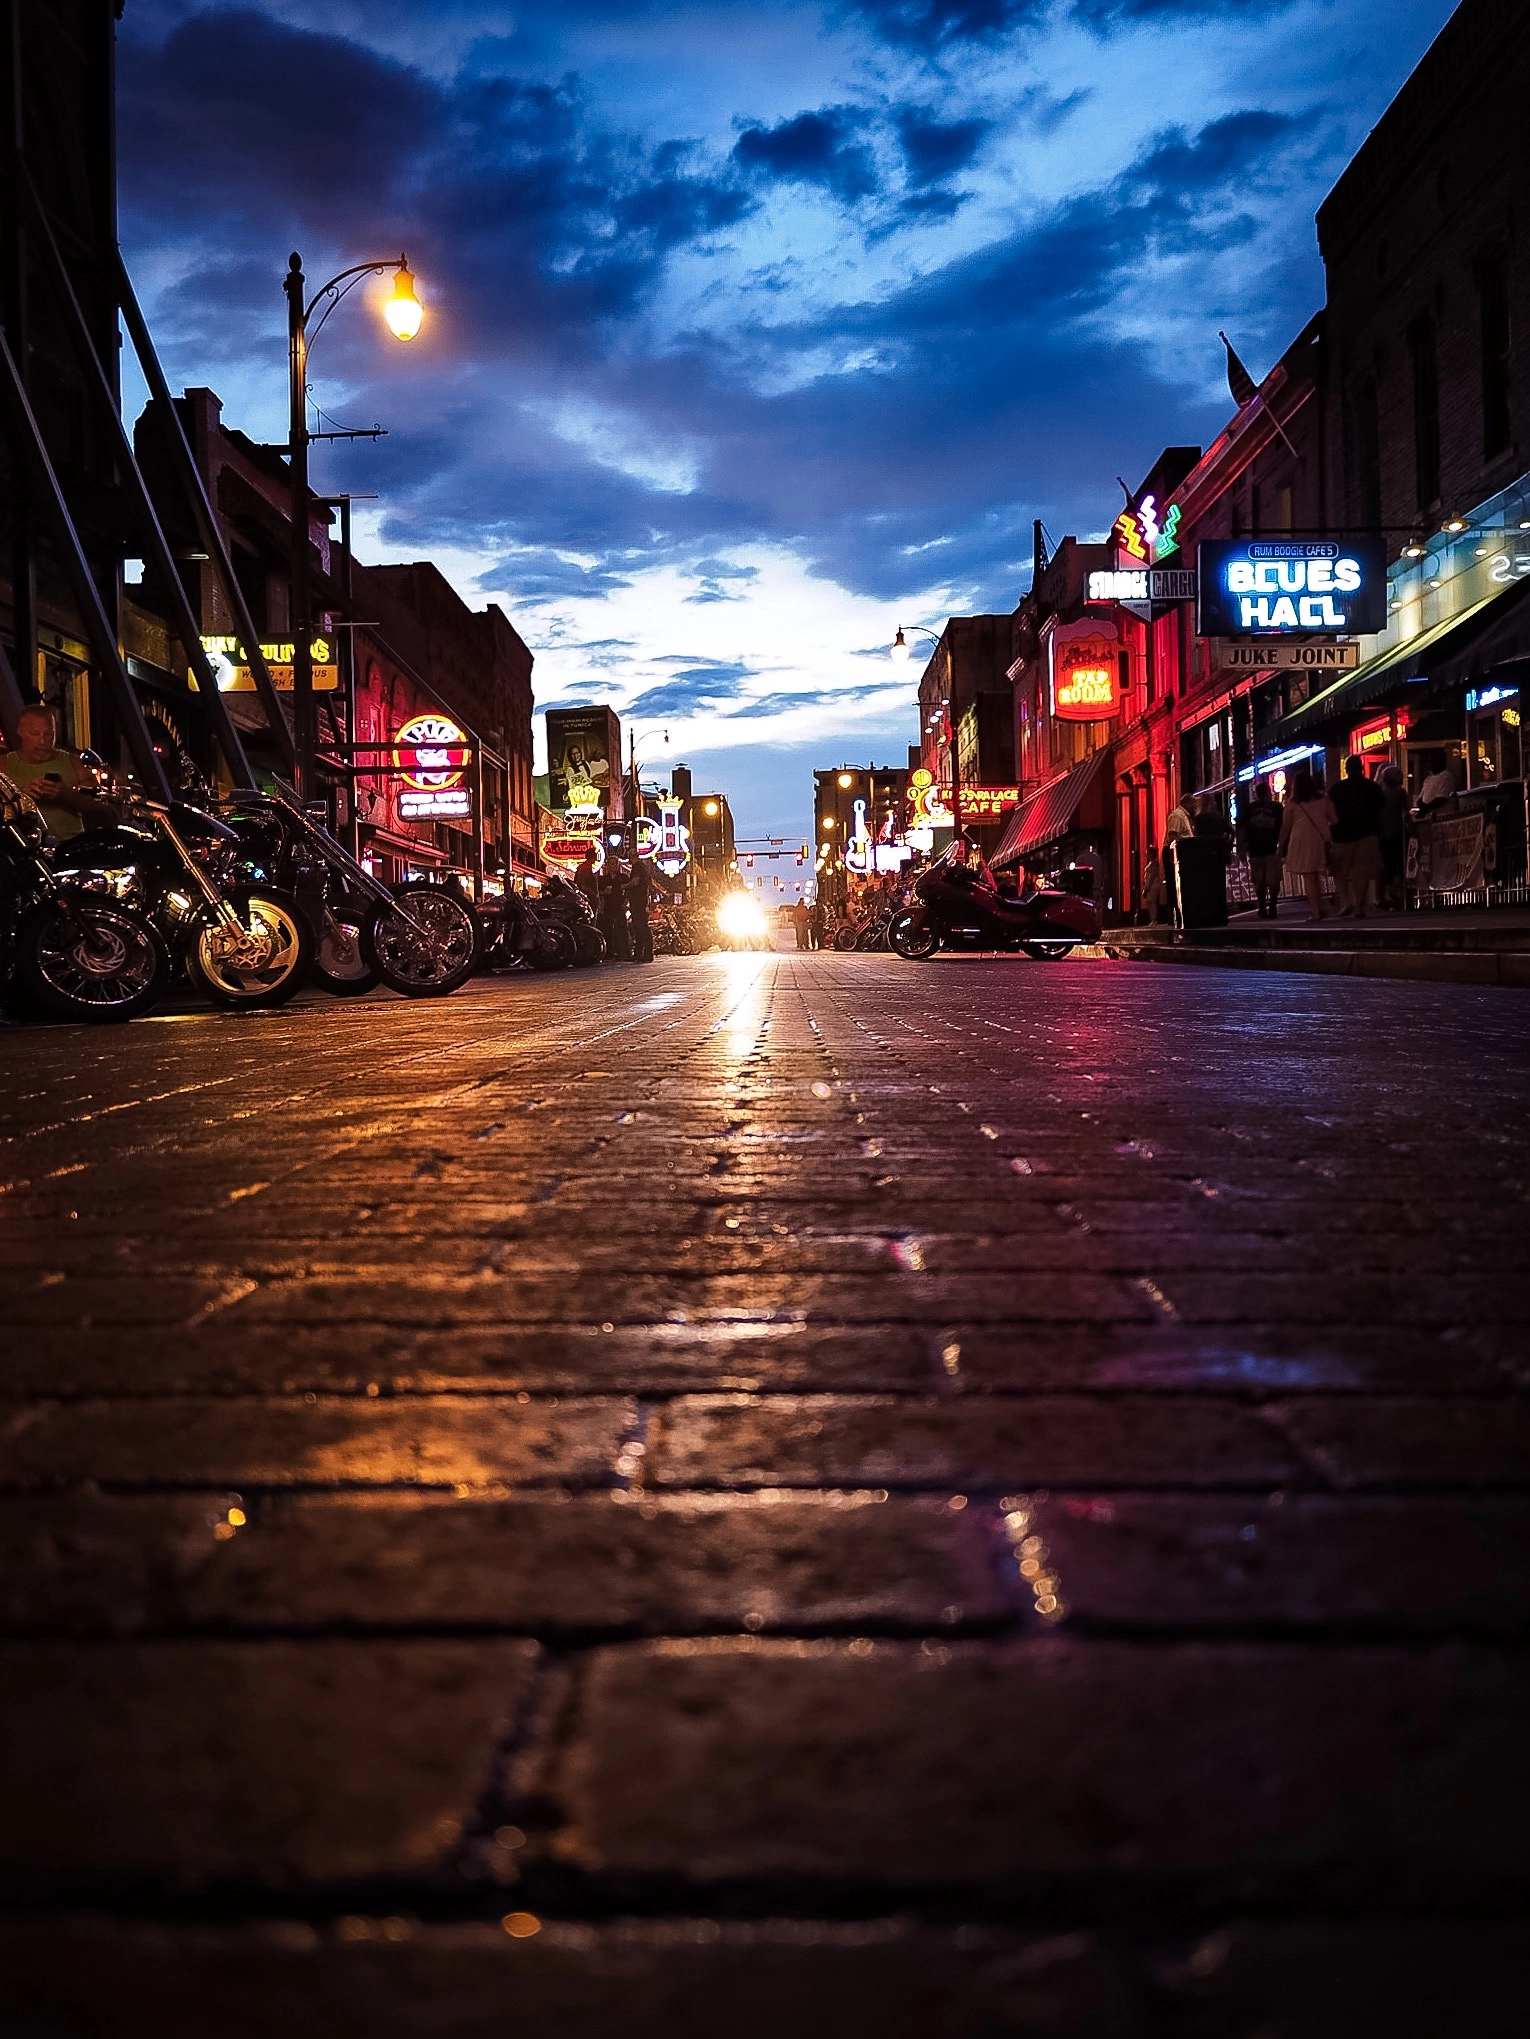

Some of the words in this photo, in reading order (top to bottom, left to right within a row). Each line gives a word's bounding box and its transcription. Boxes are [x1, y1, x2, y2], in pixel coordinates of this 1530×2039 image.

[1254, 546, 1273, 555] RUM
[1275, 546, 1304, 556] BOOGIE
[1153, 572, 1194, 597] CARGO
[1227, 559, 1362, 592] BLUES
[1240, 596, 1346, 626] HALL
[1229, 649, 1279, 665] JUKE
[1290, 648, 1348, 665] JOINT
[1058, 684, 1113, 704] ROOM
[959, 801, 1002, 814] CAFE
